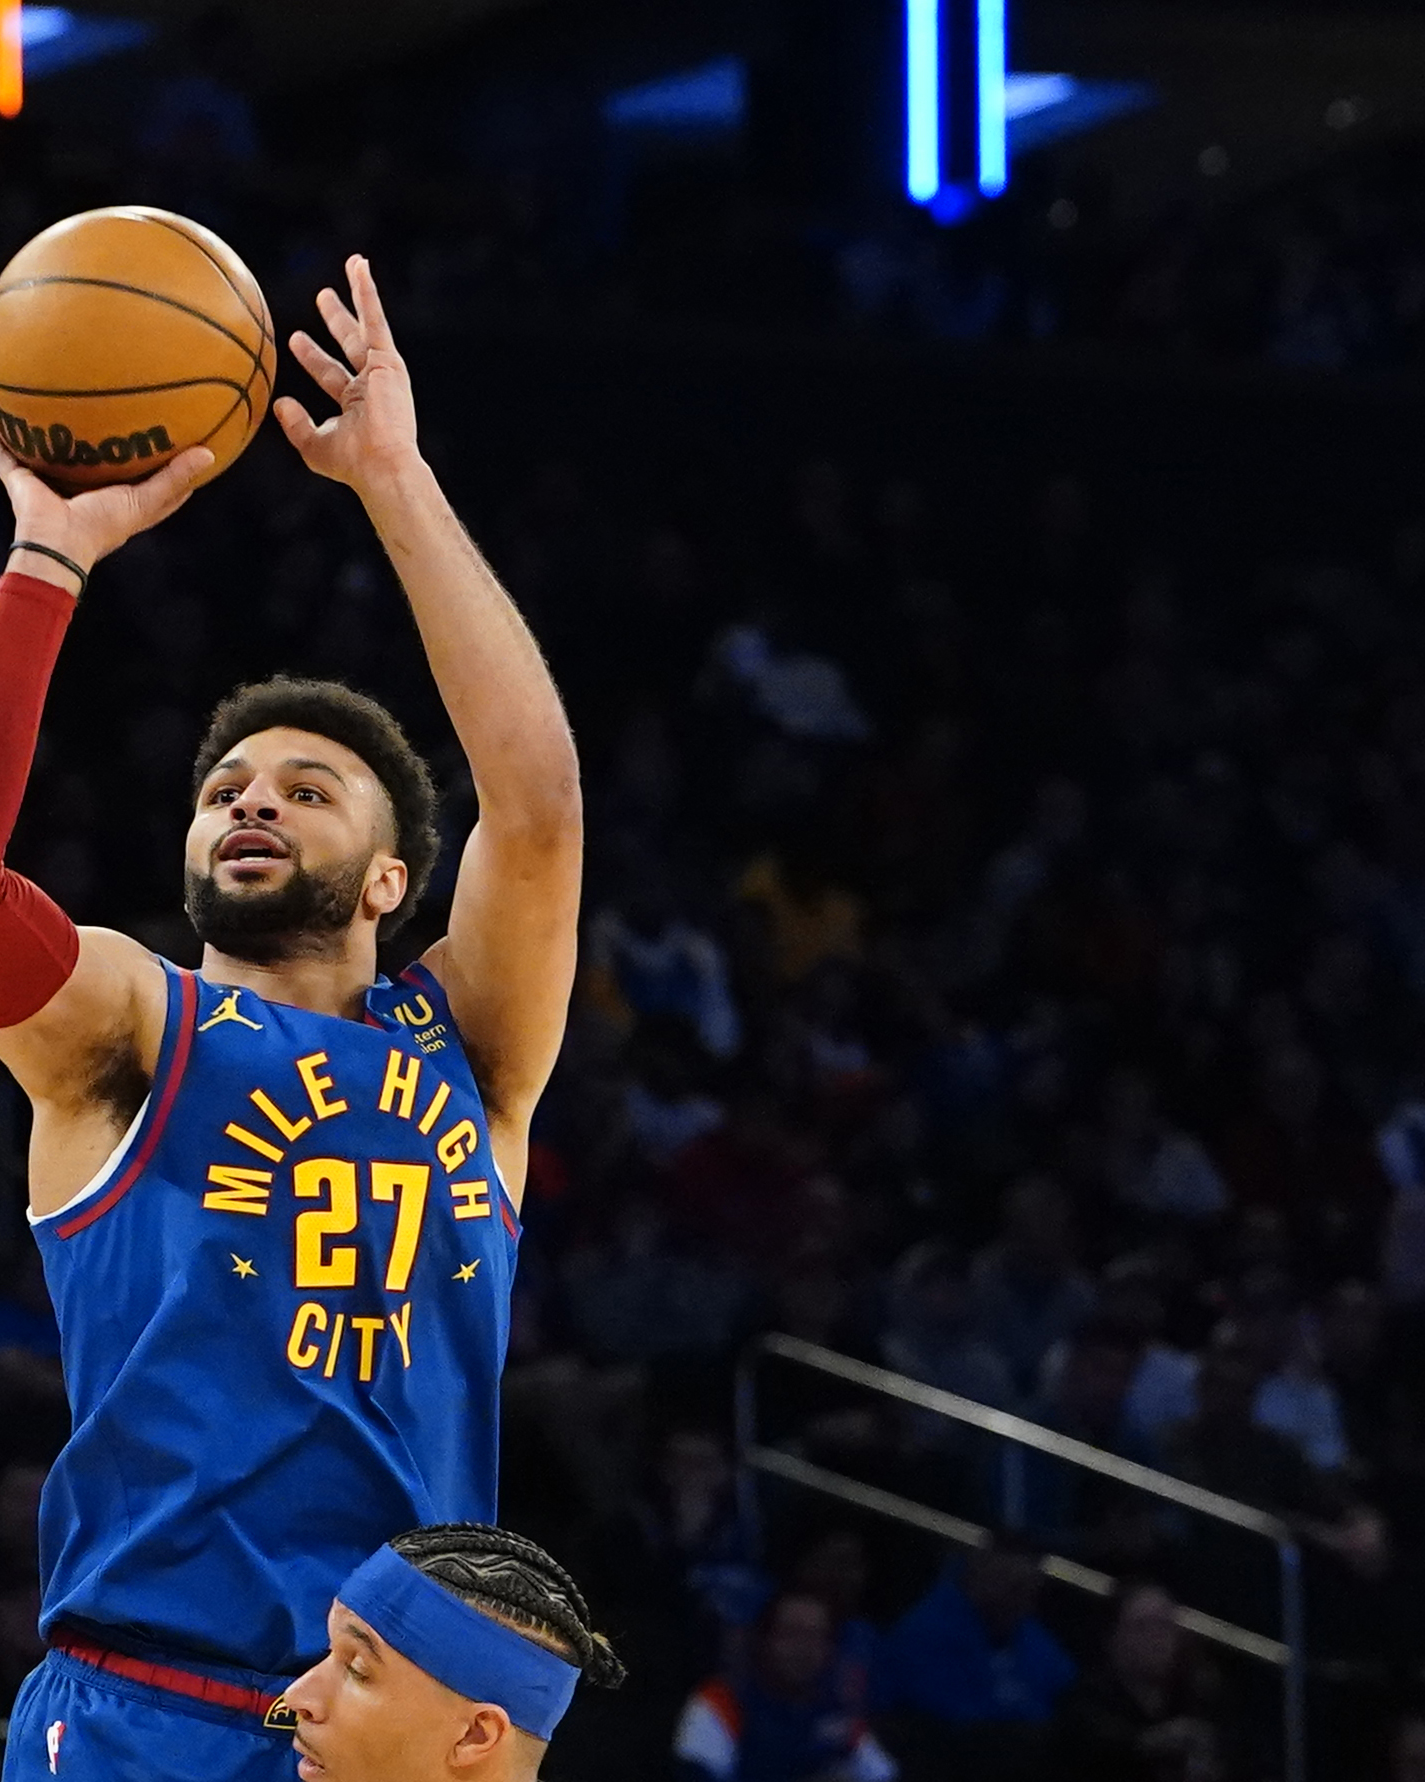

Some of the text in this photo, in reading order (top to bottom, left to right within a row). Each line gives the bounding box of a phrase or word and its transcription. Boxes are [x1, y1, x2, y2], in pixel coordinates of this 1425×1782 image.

[202, 1048, 492, 1221] MILE HIGH
[292, 1157, 432, 1293] 27
[286, 1300, 413, 1383] CITY
